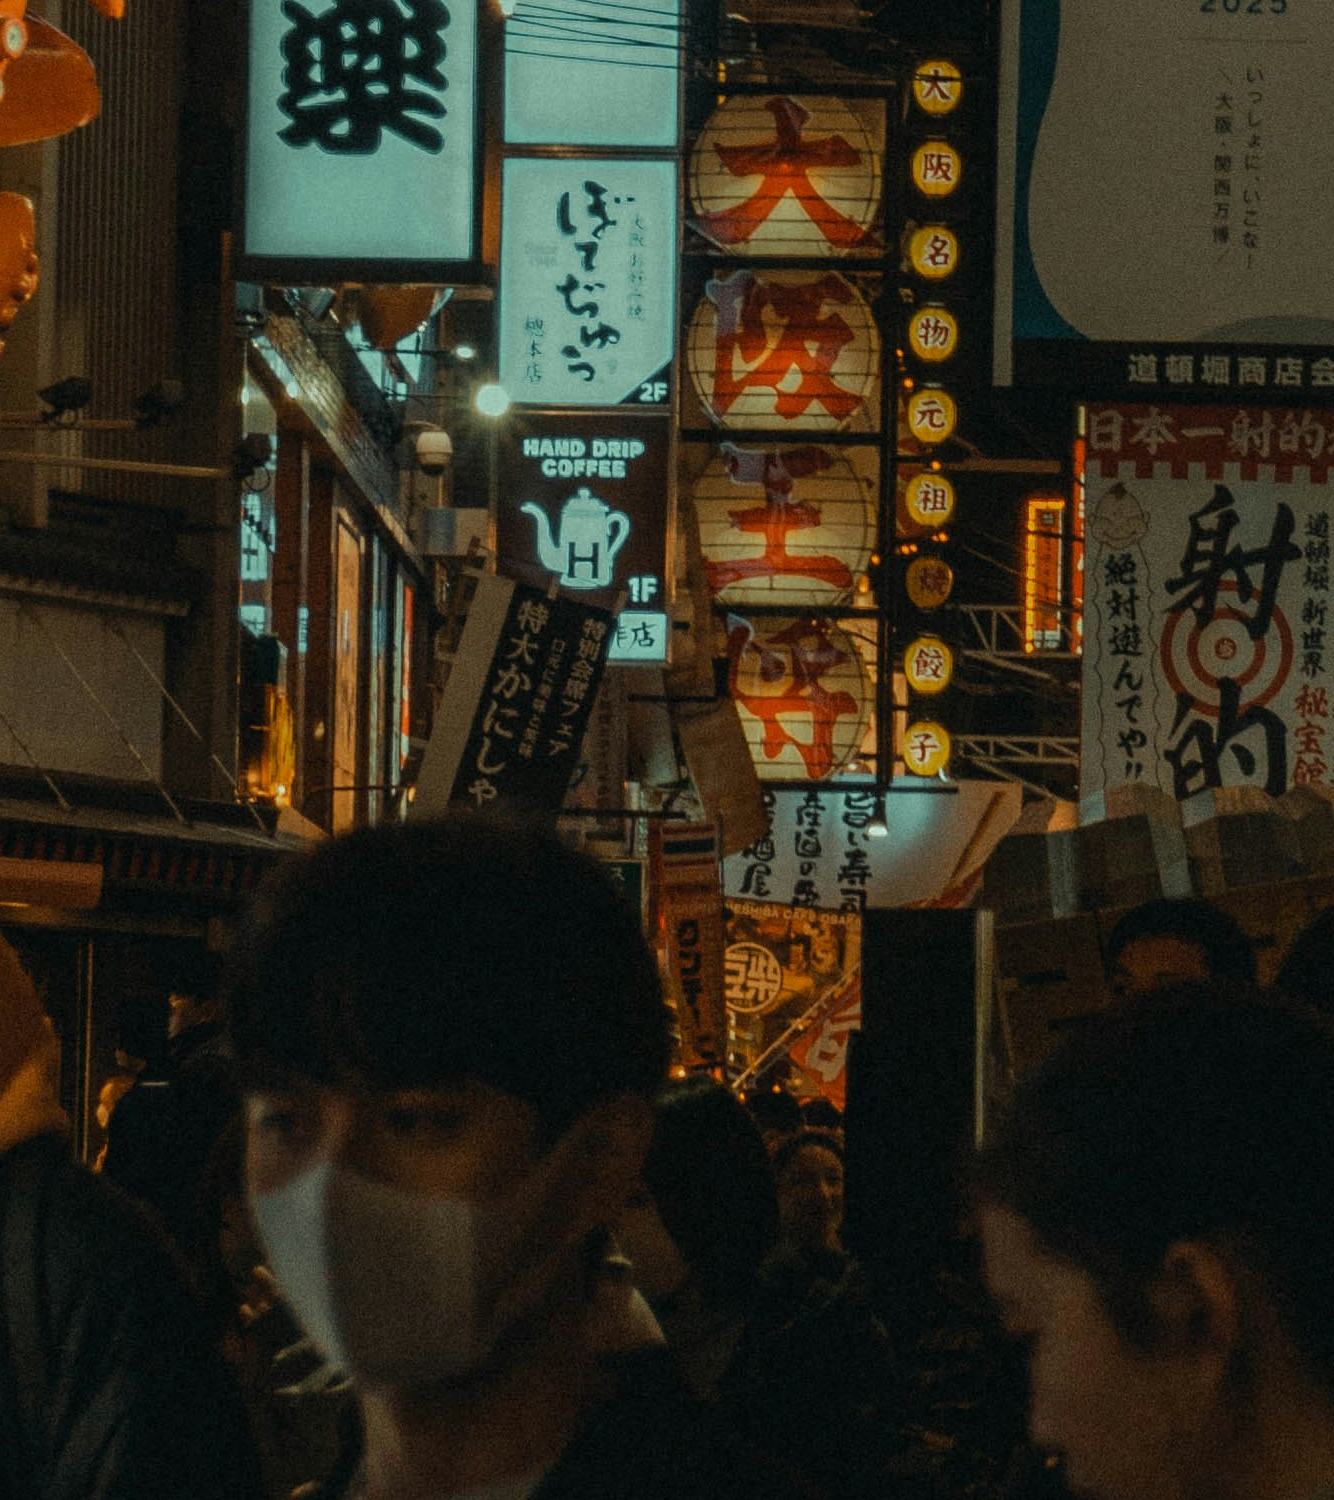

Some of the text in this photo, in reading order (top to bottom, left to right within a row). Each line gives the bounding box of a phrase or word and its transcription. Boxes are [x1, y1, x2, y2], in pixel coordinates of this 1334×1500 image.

[640, 383, 668, 402] 2F
[910, 69, 954, 764] 大阪名物元祖焼餃子
[523, 438, 646, 460] HAND DRIP
[701, 96, 878, 779] 大阪王将
[541, 459, 626, 479] COFFEE
[568, 542, 599, 580] H
[627, 577, 657, 604] 1F
[1165, 484, 1303, 797] 射的
